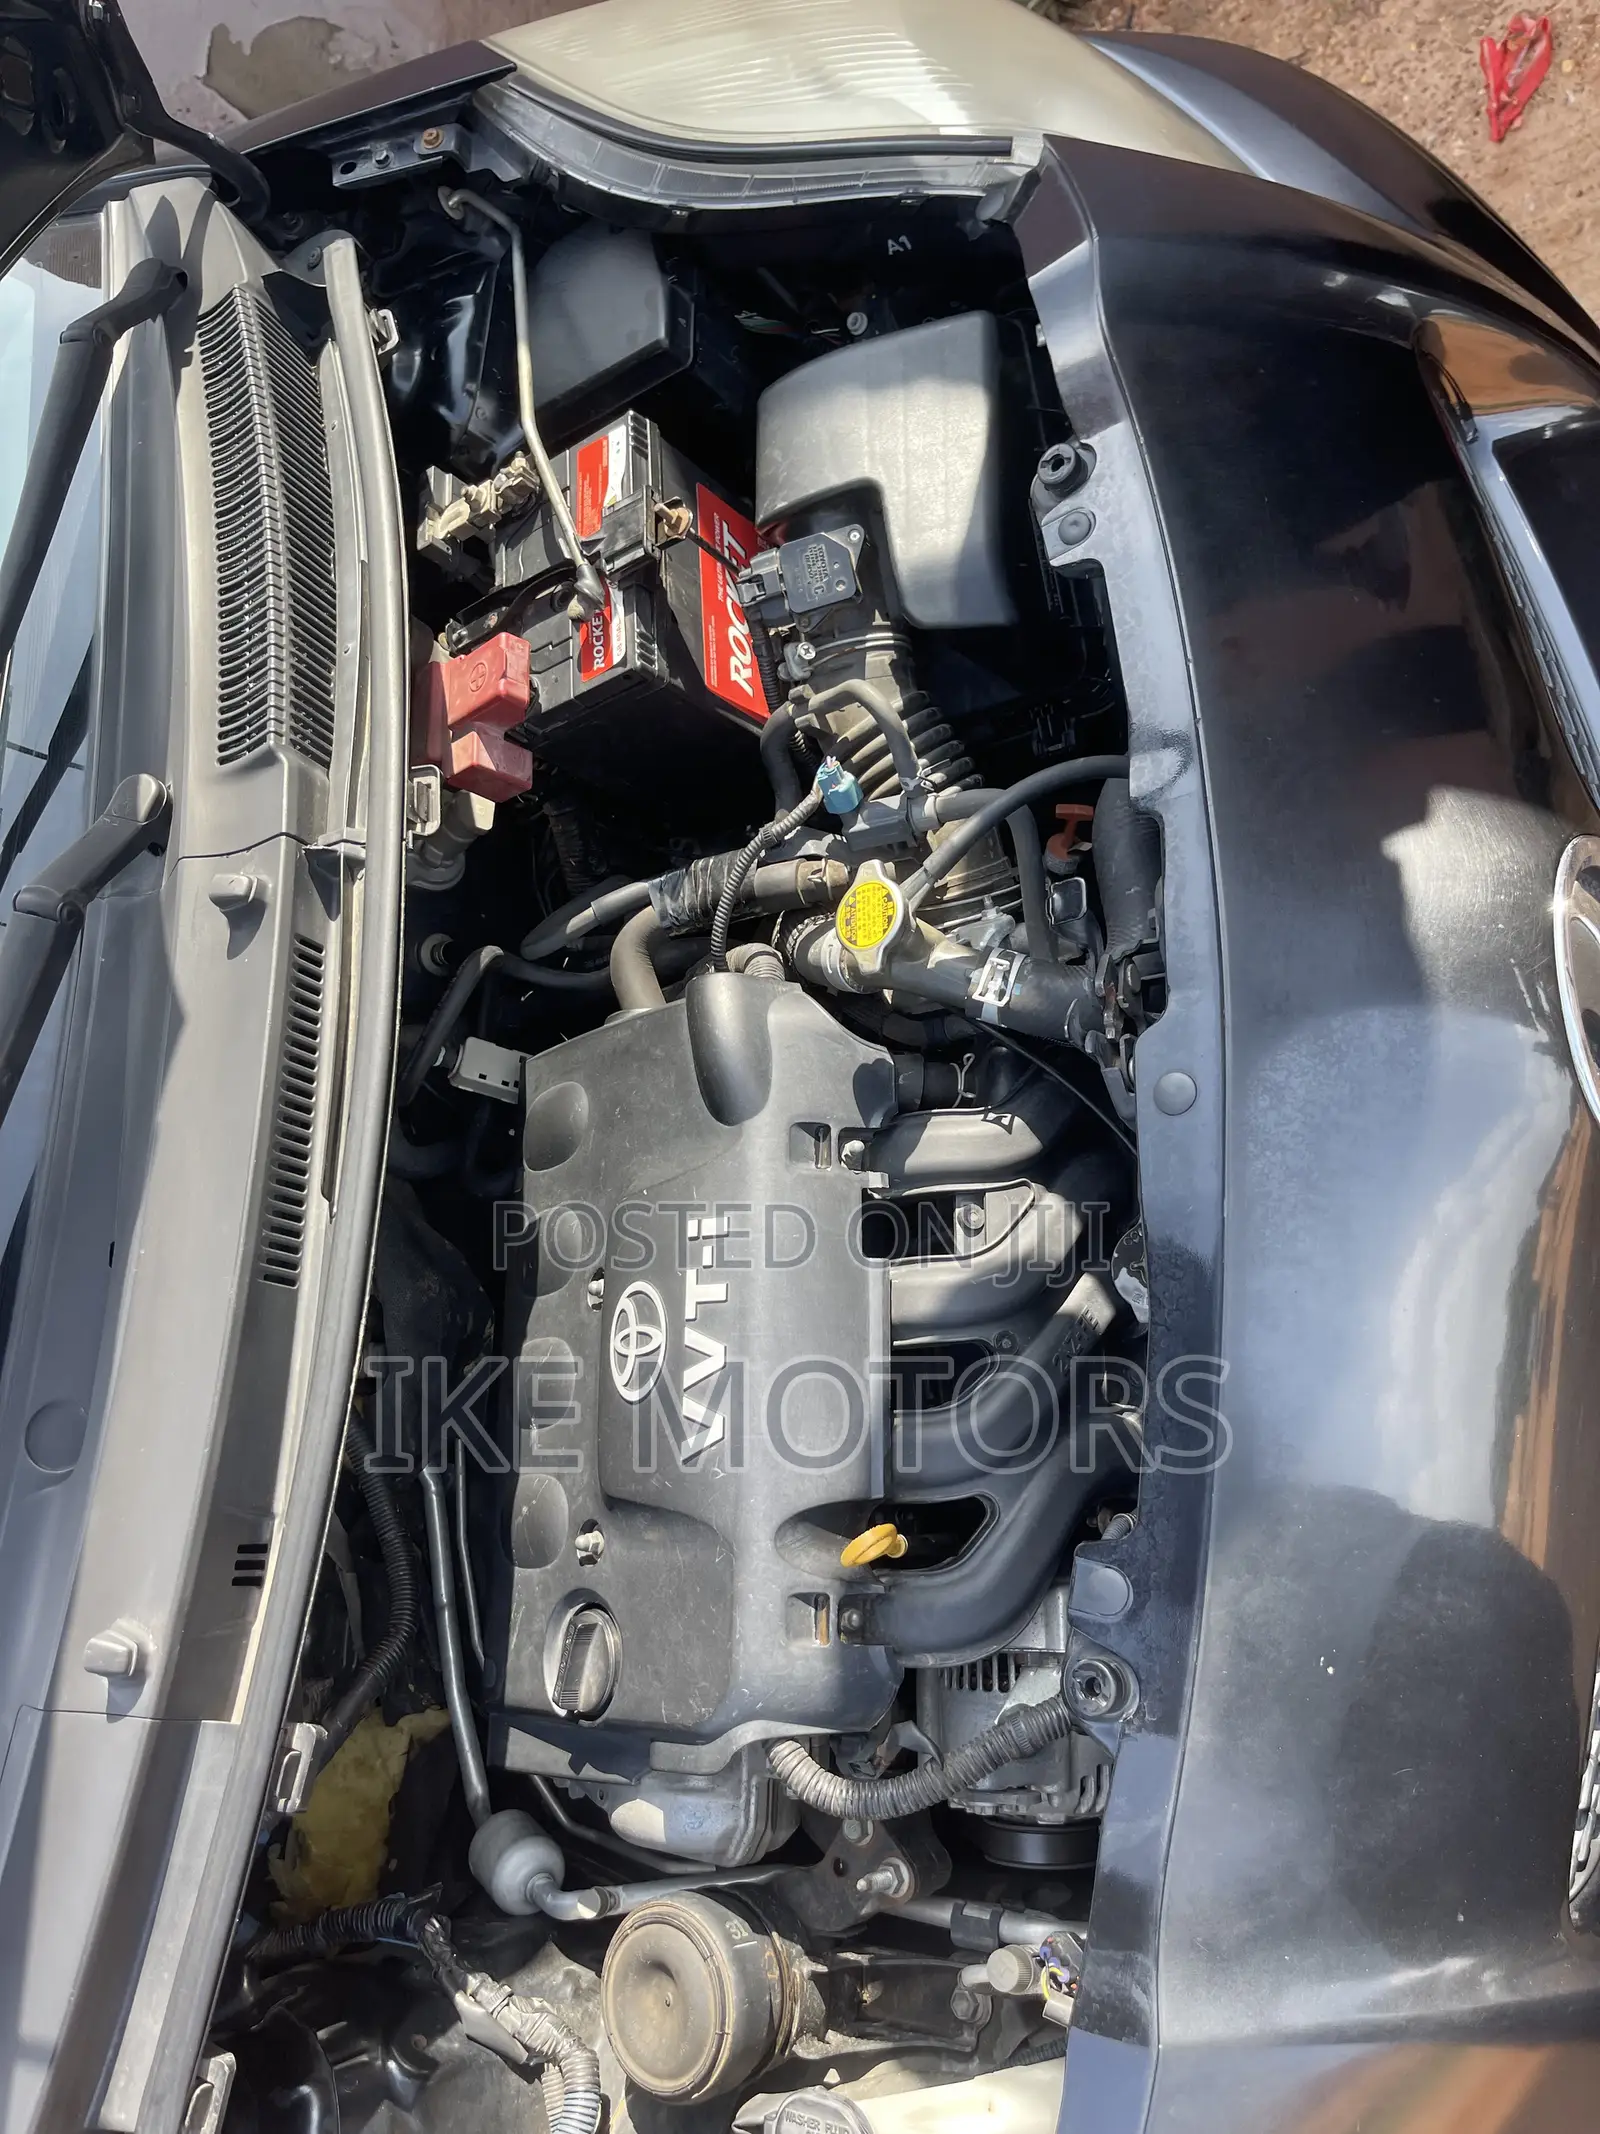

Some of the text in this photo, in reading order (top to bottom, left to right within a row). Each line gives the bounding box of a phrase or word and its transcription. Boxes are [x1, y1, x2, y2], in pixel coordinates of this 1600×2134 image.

[713, 512, 722, 544] POWER
[818, 546, 829, 579] TOYOTA
[850, 907, 858, 941] ATTENTION
[784, 2107, 821, 2132] WASHER
